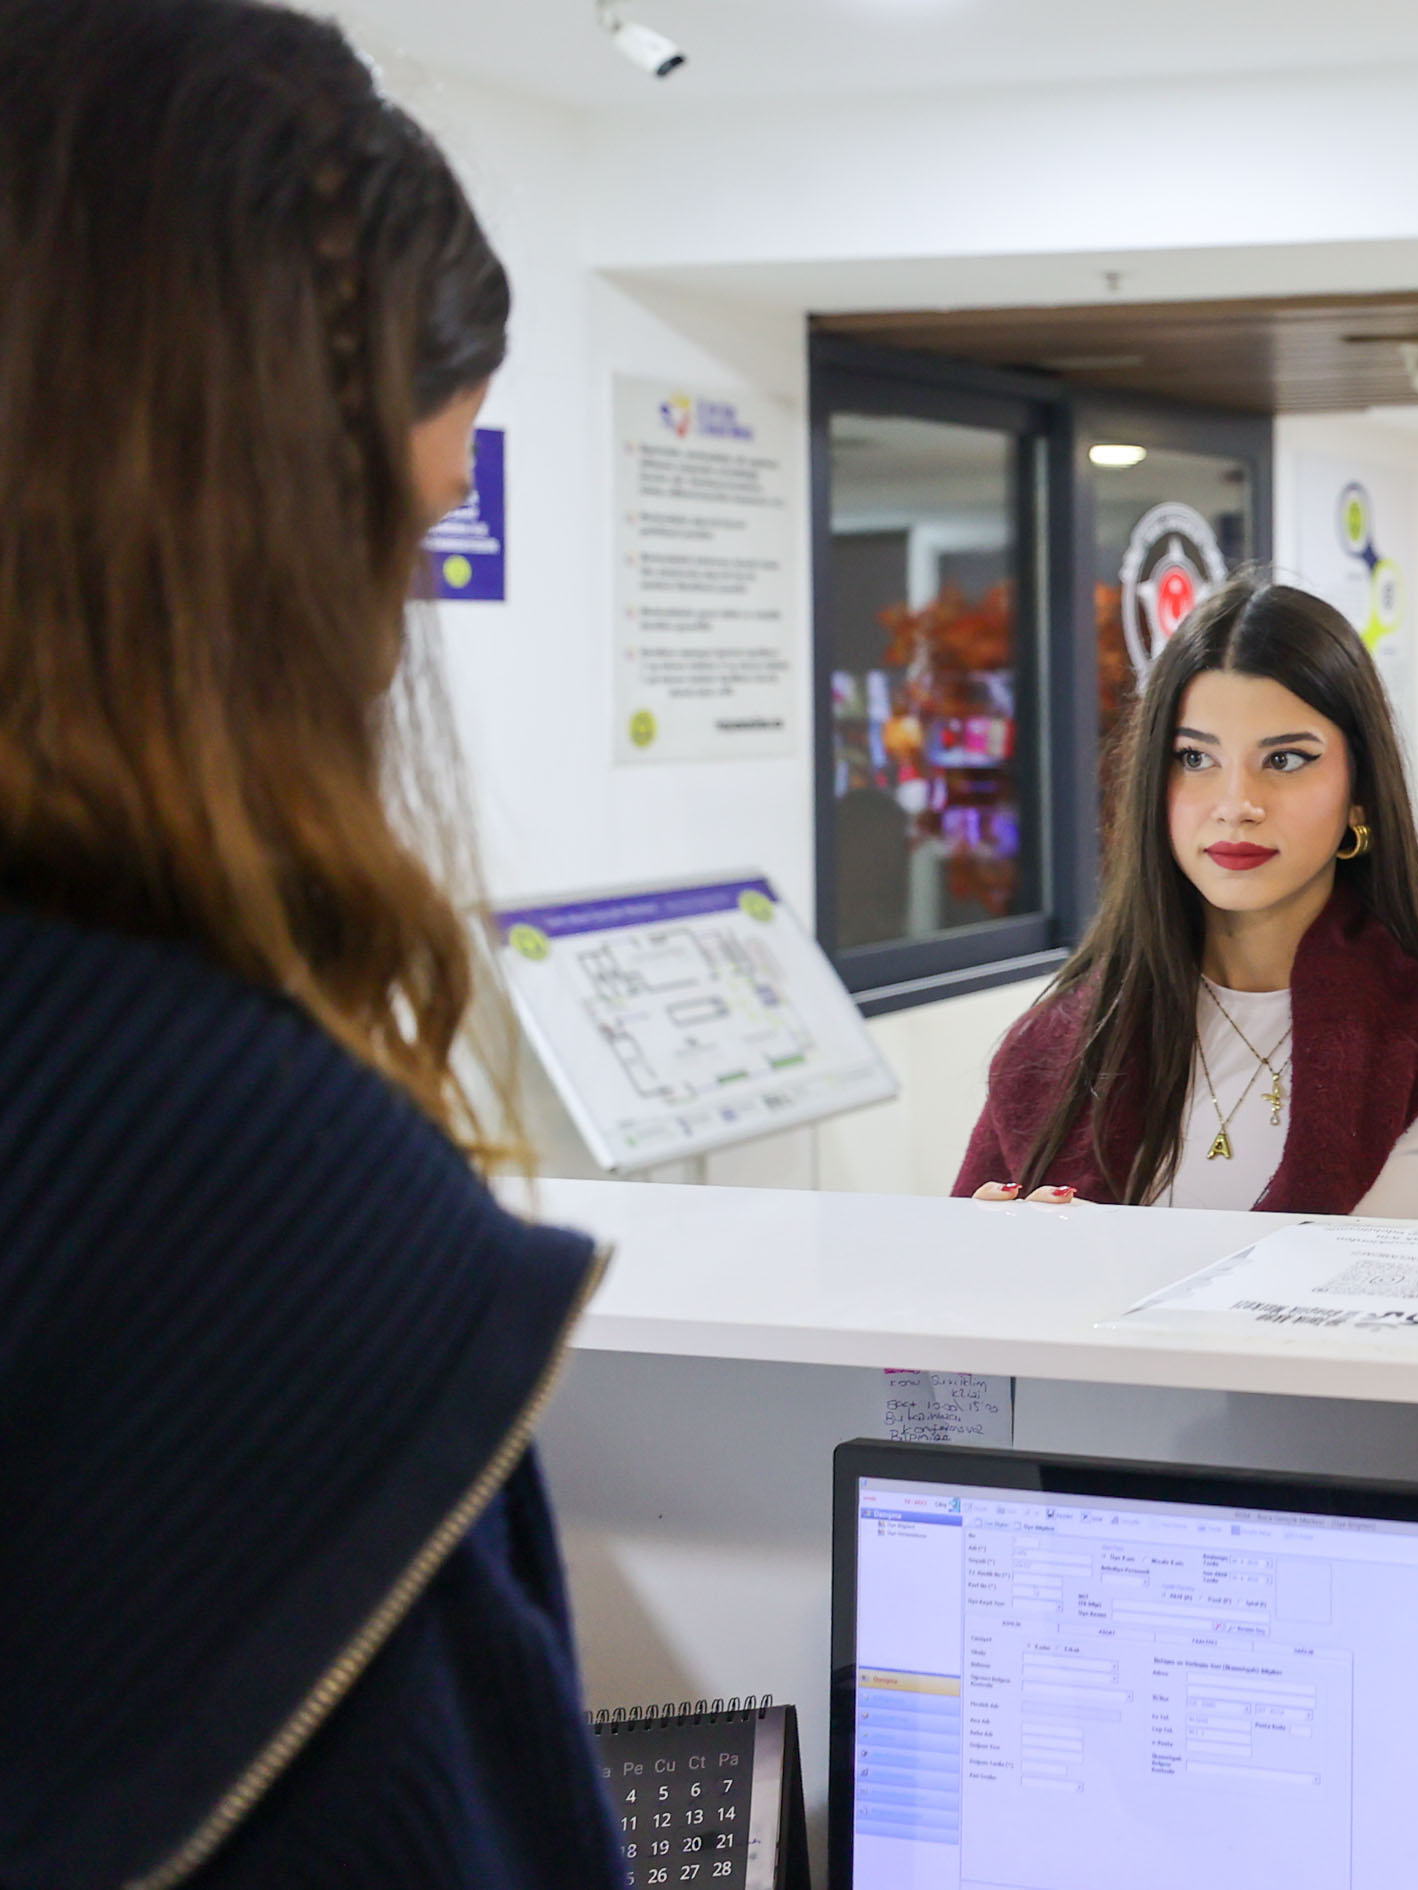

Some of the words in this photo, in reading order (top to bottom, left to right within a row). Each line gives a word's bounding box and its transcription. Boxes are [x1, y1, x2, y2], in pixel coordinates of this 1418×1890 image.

[623, 1761, 644, 1776] Pe
[654, 1759, 676, 1774] Cu
[688, 1756, 706, 1770] Ct
[718, 1753, 739, 1766] Pa
[626, 1789, 637, 1803] 4
[658, 1786, 669, 1800] 5
[690, 1783, 701, 1797] 6
[722, 1779, 733, 1793] 7
[620, 1816, 638, 1831] 11
[653, 1813, 671, 1828] 12
[685, 1809, 704, 1825] 13
[717, 1806, 736, 1821] 14
[651, 1840, 670, 1856] 19
[683, 1837, 702, 1852] 20
[716, 1834, 734, 1849] 21
[648, 1868, 668, 1884] 26
[680, 1864, 700, 1880] 27
[712, 1861, 732, 1877] 28
